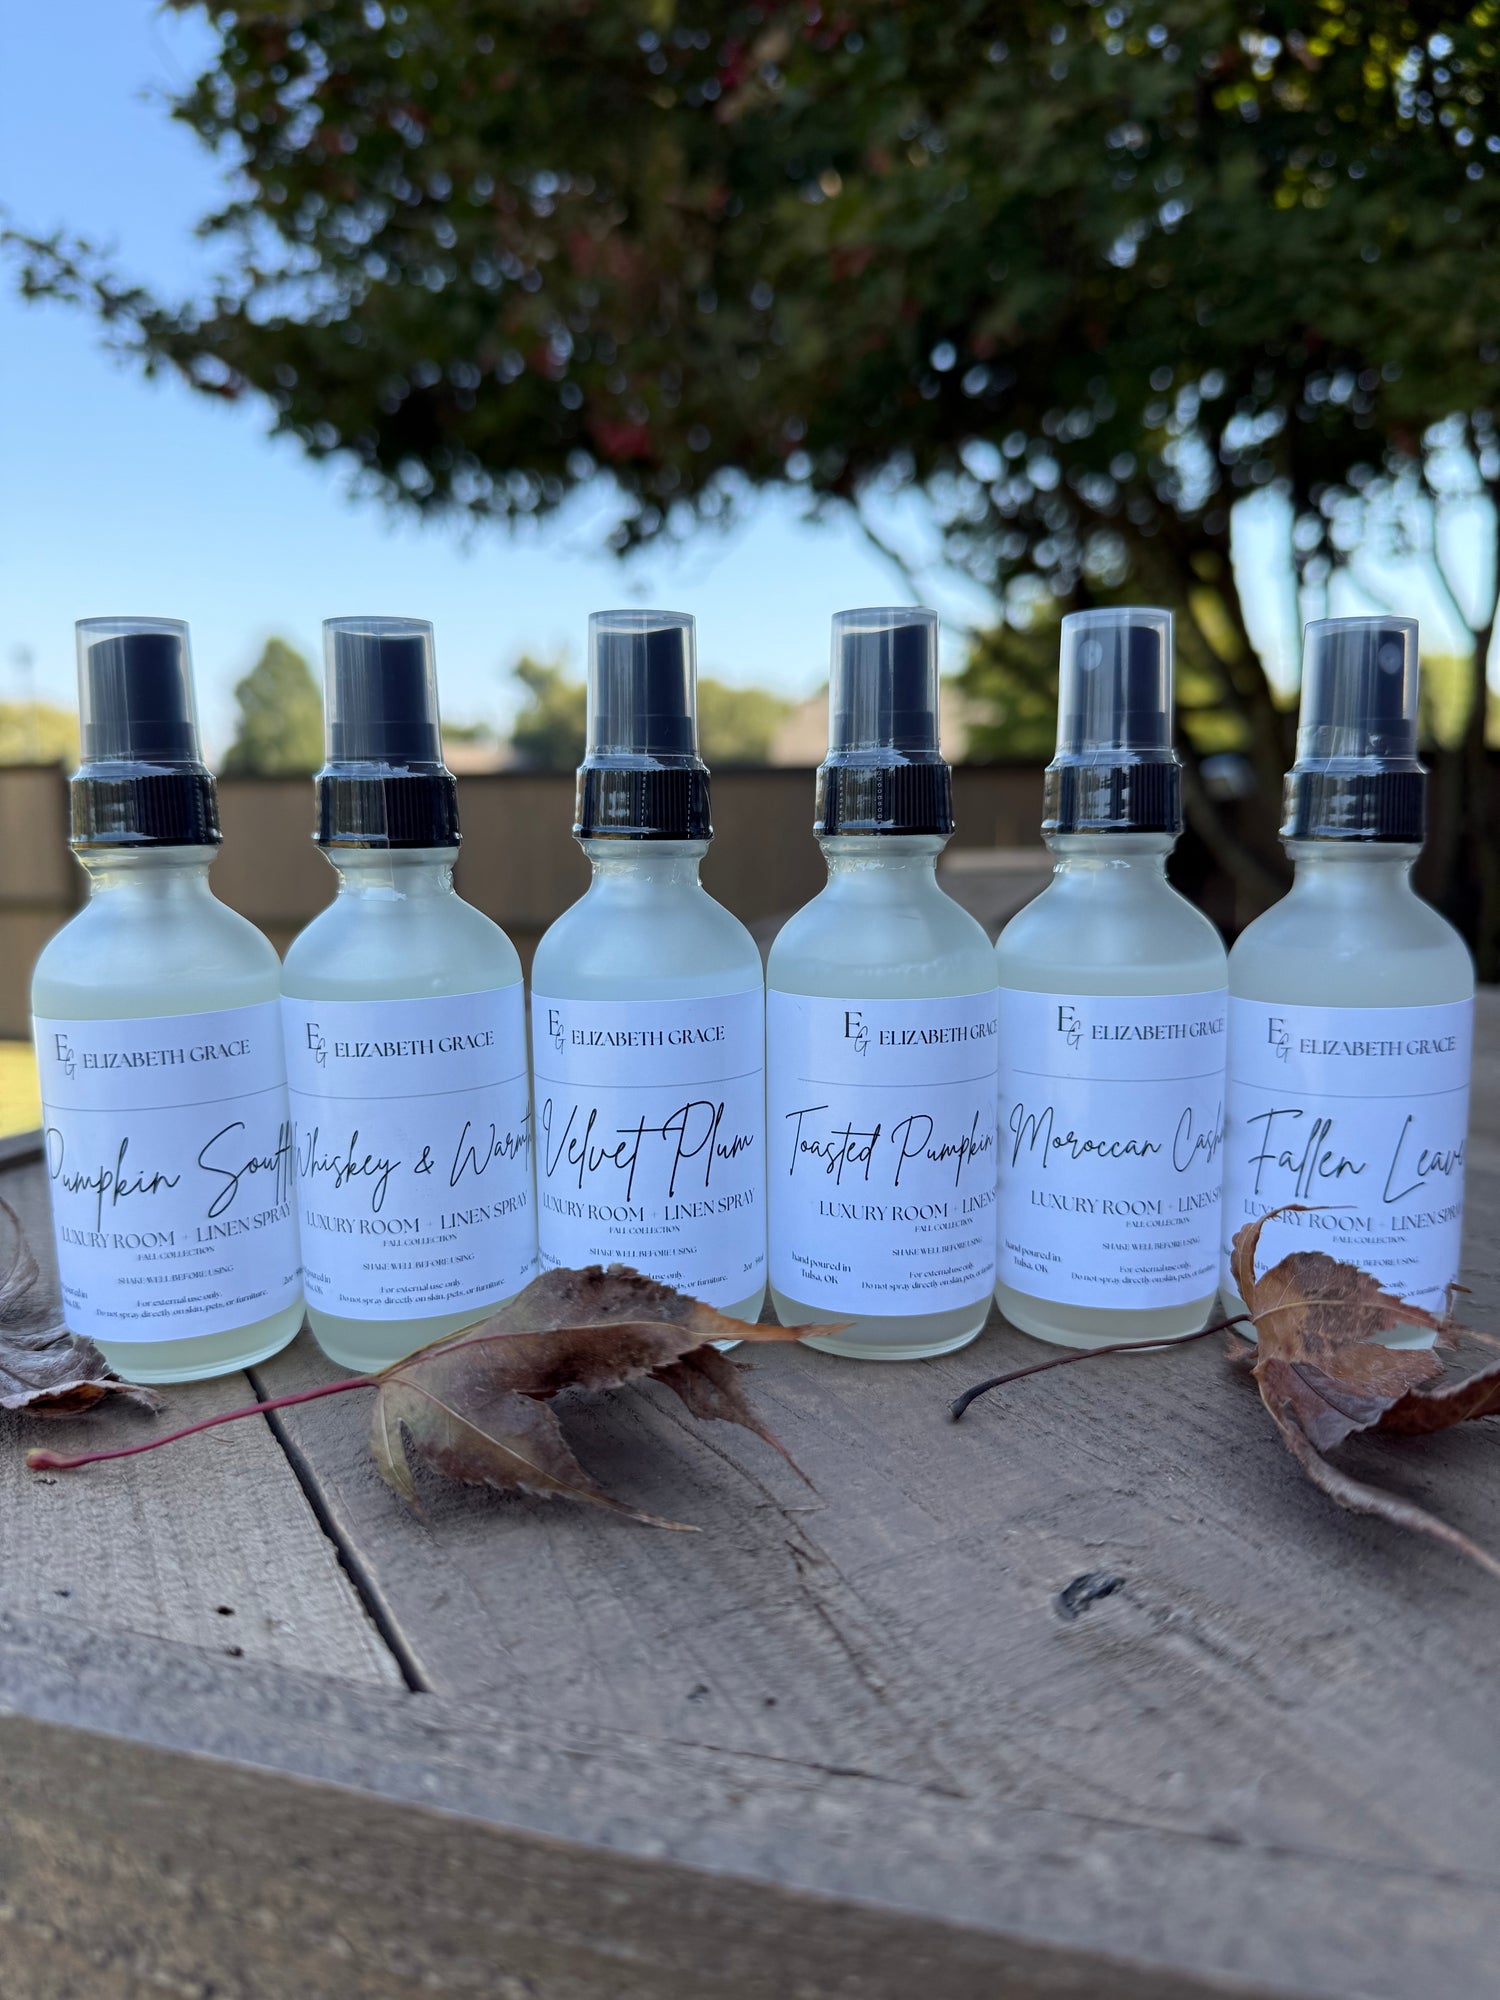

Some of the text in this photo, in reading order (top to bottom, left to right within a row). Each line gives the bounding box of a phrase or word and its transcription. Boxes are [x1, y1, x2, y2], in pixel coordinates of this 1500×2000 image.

[572, 1029, 663, 1047] ELIZABETH
[668, 1026, 726, 1045] GRACE
[879, 1028, 967, 1046] ELIZABETH
[1092, 1022, 1186, 1041] ELIZABETH
[1189, 1017, 1225, 1038] GRACE
[335, 1039, 434, 1058] ELIZABETH
[438, 1031, 494, 1052] GRACE
[1300, 1038, 1401, 1056] ELIZABETH
[1406, 1036, 1456, 1055] GRACE
[84, 1048, 185, 1069] ELIZABETH
[190, 1039, 251, 1062] GRACE
[1009, 1103, 1162, 1169] Moroccan
[542, 1098, 754, 1202] Velvet Plum
[785, 1105, 993, 1187] Toasted Pumpkin
[1247, 1108, 1368, 1198] Fallen
[295, 1120, 401, 1212] Whiskey
[414, 1146, 434, 1174] &
[543, 1191, 585, 1218] LUXURY
[588, 1205, 644, 1222] ROOM
[665, 1201, 715, 1221] LINEN
[718, 1187, 755, 1213] SPRAY
[819, 1200, 888, 1221] LUXURY
[892, 1202, 948, 1221] ROOM
[962, 1191, 993, 1214] LINEN
[1031, 1190, 1099, 1214] LUXURY
[1103, 1200, 1162, 1216] ROOM
[1179, 1190, 1212, 1212] LINEN
[307, 1191, 529, 1235] LUXURY ROOM LINEN SPRAY
[1309, 1213, 1371, 1231] ROOM
[1392, 1212, 1435, 1231] LINEN
[62, 1205, 291, 1249] LUXURY ROOM LINEN SPRAY
[629, 1225, 681, 1234] COLLECTION
[914, 1217, 973, 1233] FALL COLLECTION
[1126, 1217, 1191, 1228] FALL COLLECTION
[383, 1233, 457, 1247] FALL COLLECTION
[1102, 1242, 1130, 1250] SHAKE
[1131, 1242, 1153, 1250] WELL
[1154, 1240, 1181, 1249] BEFORE
[1354, 1235, 1406, 1243] COLLECTION
[138, 1246, 215, 1262] FALL COLLECTION
[589, 1248, 614, 1257] SHAKE
[638, 1249, 672, 1258] BEFORE
[673, 1246, 698, 1256] USING
[892, 1248, 919, 1256] SHAKE
[920, 1247, 939, 1255] WELL
[942, 1242, 966, 1253] BEFORE
[1005, 1239, 1061, 1263] hand poured in
[363, 1253, 475, 1270] SHAKE WELL BEFORE USING
[792, 1251, 851, 1272] hand poured in
[1013, 1256, 1048, 1273] Tulsa, OK
[1120, 1265, 1133, 1273] For
[1135, 1264, 1164, 1273] external
[1396, 1257, 1418, 1265] USING
[118, 1265, 234, 1285] SHAKE WELL BEFORE USING
[801, 1269, 838, 1285] Tulsa, OK
[909, 1271, 922, 1279] For
[924, 1265, 951, 1277] external
[1071, 1272, 1081, 1280] Do
[1082, 1273, 1097, 1283] not
[1099, 1275, 1120, 1285] spray
[1122, 1273, 1150, 1284] directly
[396, 1282, 431, 1293] external
[862, 1281, 873, 1289] Do
[874, 1281, 887, 1290] not
[889, 1282, 910, 1292] spray
[911, 1279, 938, 1290] directly
[152, 1296, 187, 1307] external
[362, 1296, 382, 1305] spray
[384, 1293, 413, 1305] directly
[119, 1310, 139, 1319] spray
[141, 1307, 172, 1318] directly
